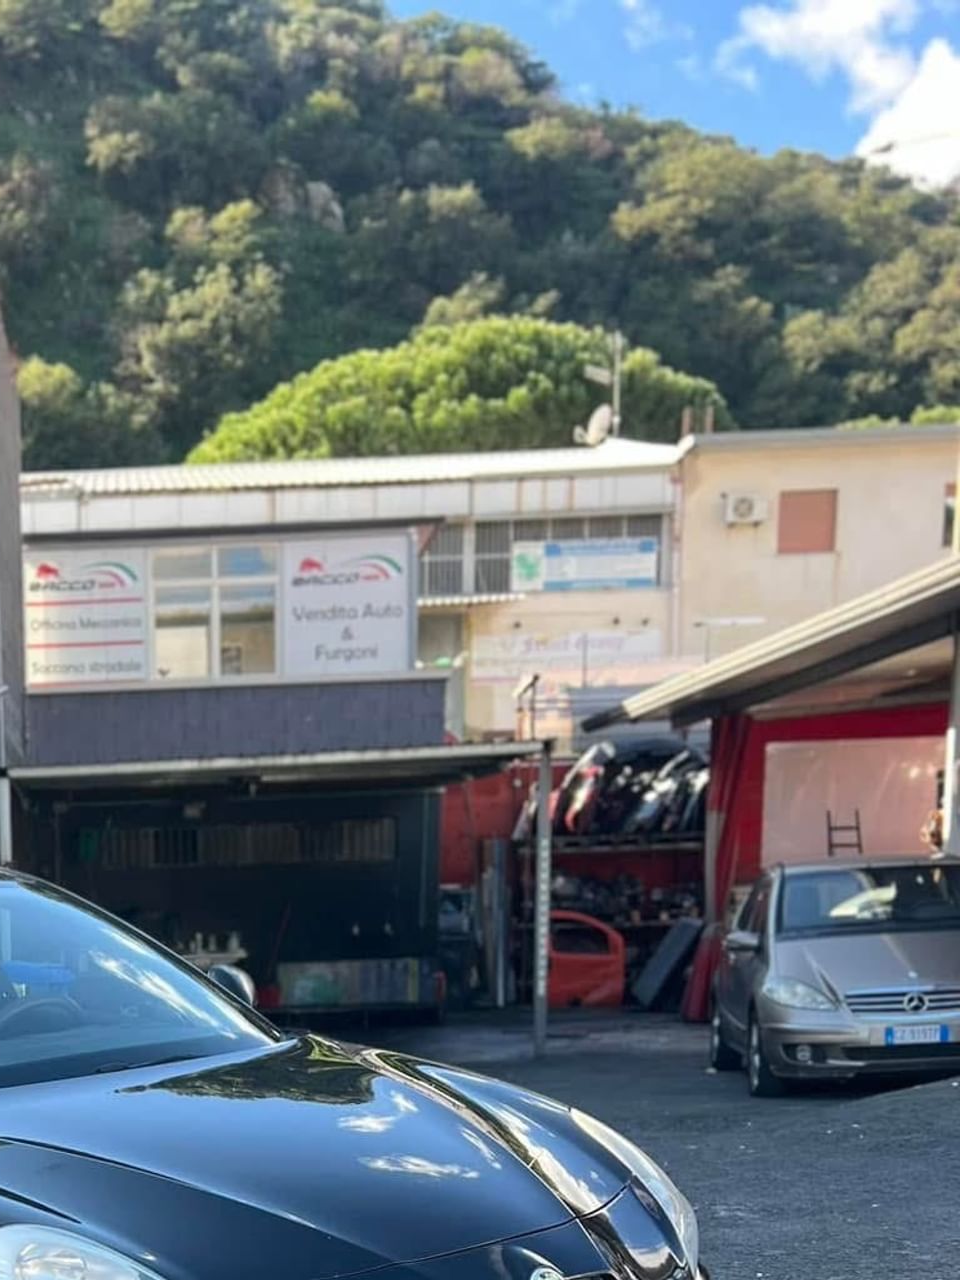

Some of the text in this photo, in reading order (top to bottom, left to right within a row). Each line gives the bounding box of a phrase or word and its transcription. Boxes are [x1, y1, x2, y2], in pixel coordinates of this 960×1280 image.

[292, 602, 404, 621] Vendita Auto
[341, 626, 354, 640] &
[314, 643, 378, 663] Furgoni
